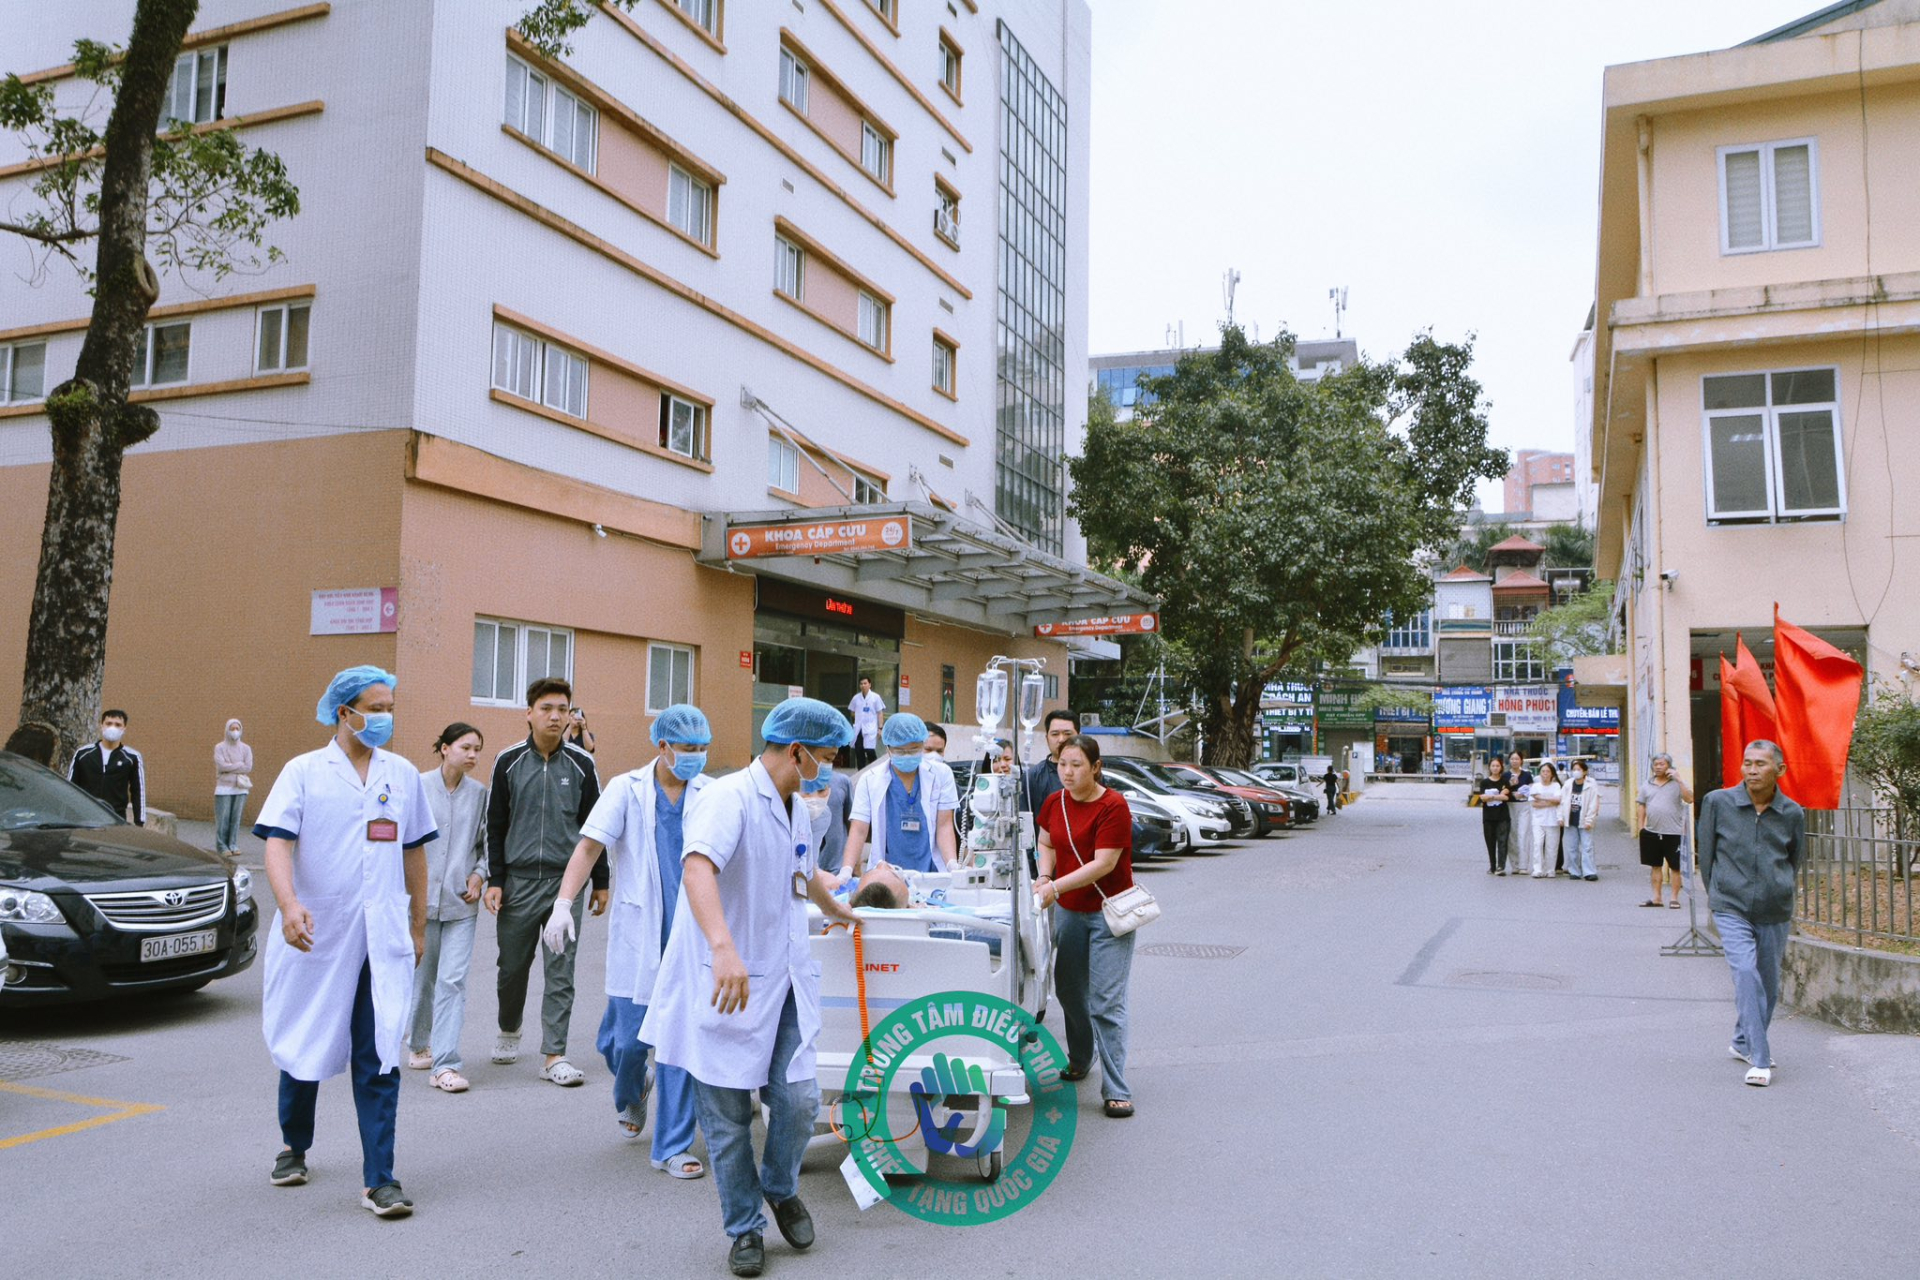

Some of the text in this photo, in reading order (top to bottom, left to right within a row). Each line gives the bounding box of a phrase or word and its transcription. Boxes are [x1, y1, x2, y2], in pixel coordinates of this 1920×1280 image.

[765, 530, 803, 542] KHOA
[807, 525, 834, 540] CẤP
[775, 541, 812, 551] Emergency
[814, 538, 855, 549] Department
[1319, 694, 1348, 704] MINH
[862, 963, 900, 972] INET
